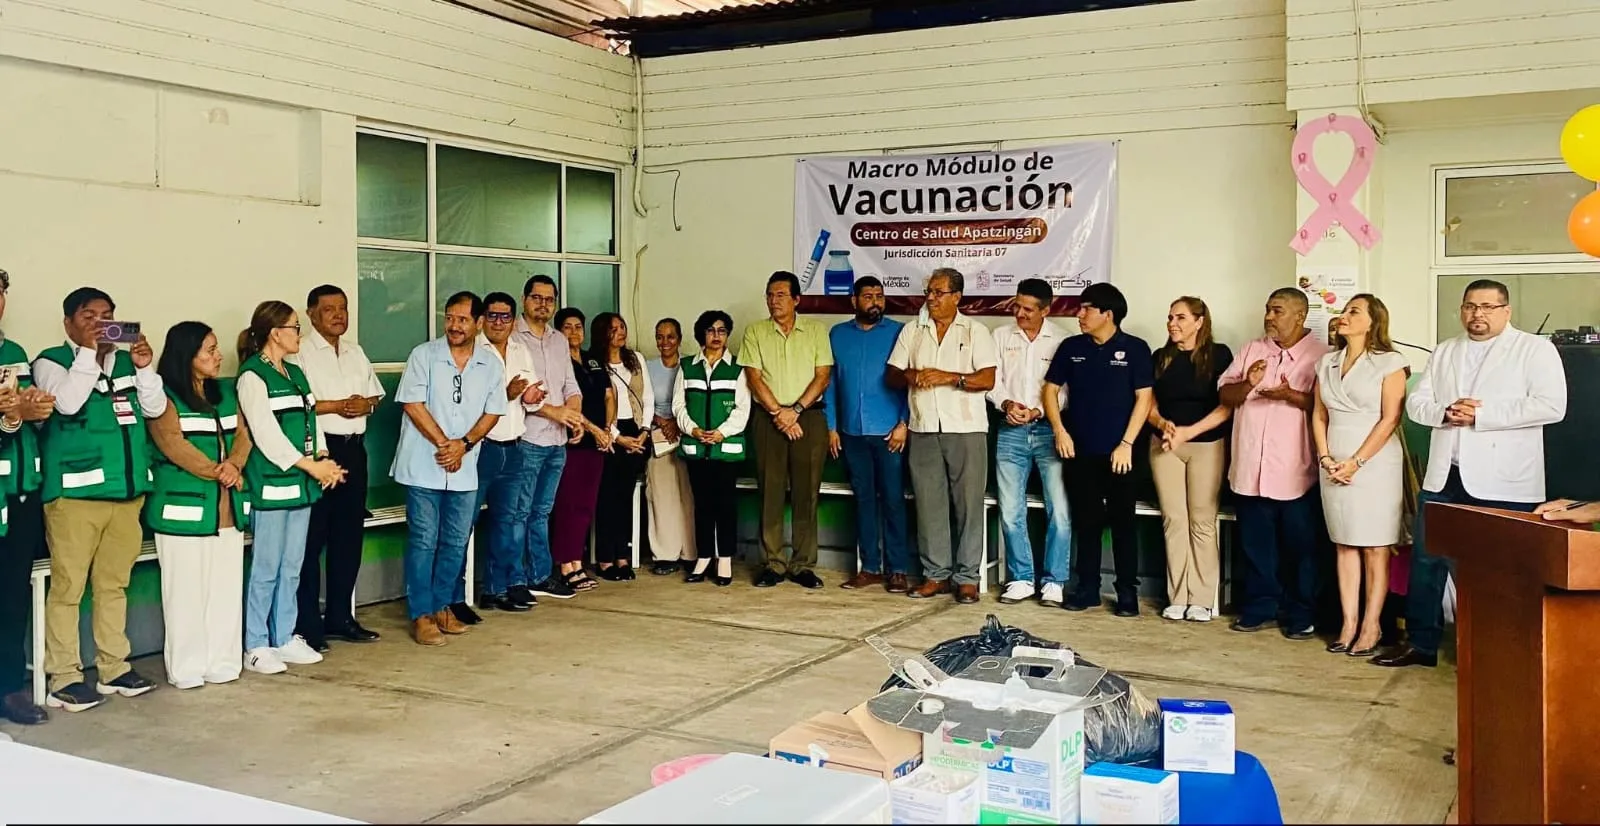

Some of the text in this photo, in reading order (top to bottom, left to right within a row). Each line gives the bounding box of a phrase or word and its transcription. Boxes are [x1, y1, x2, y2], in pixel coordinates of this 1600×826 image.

[848, 151, 1054, 178] Macro Módulo de
[828, 174, 1073, 215] Vacunación
[855, 225, 1042, 241] Centro de Salud Apatzingán
[884, 247, 1007, 260] Jurisdicción Sanitaria 07
[1060, 731, 1083, 762] DLP
